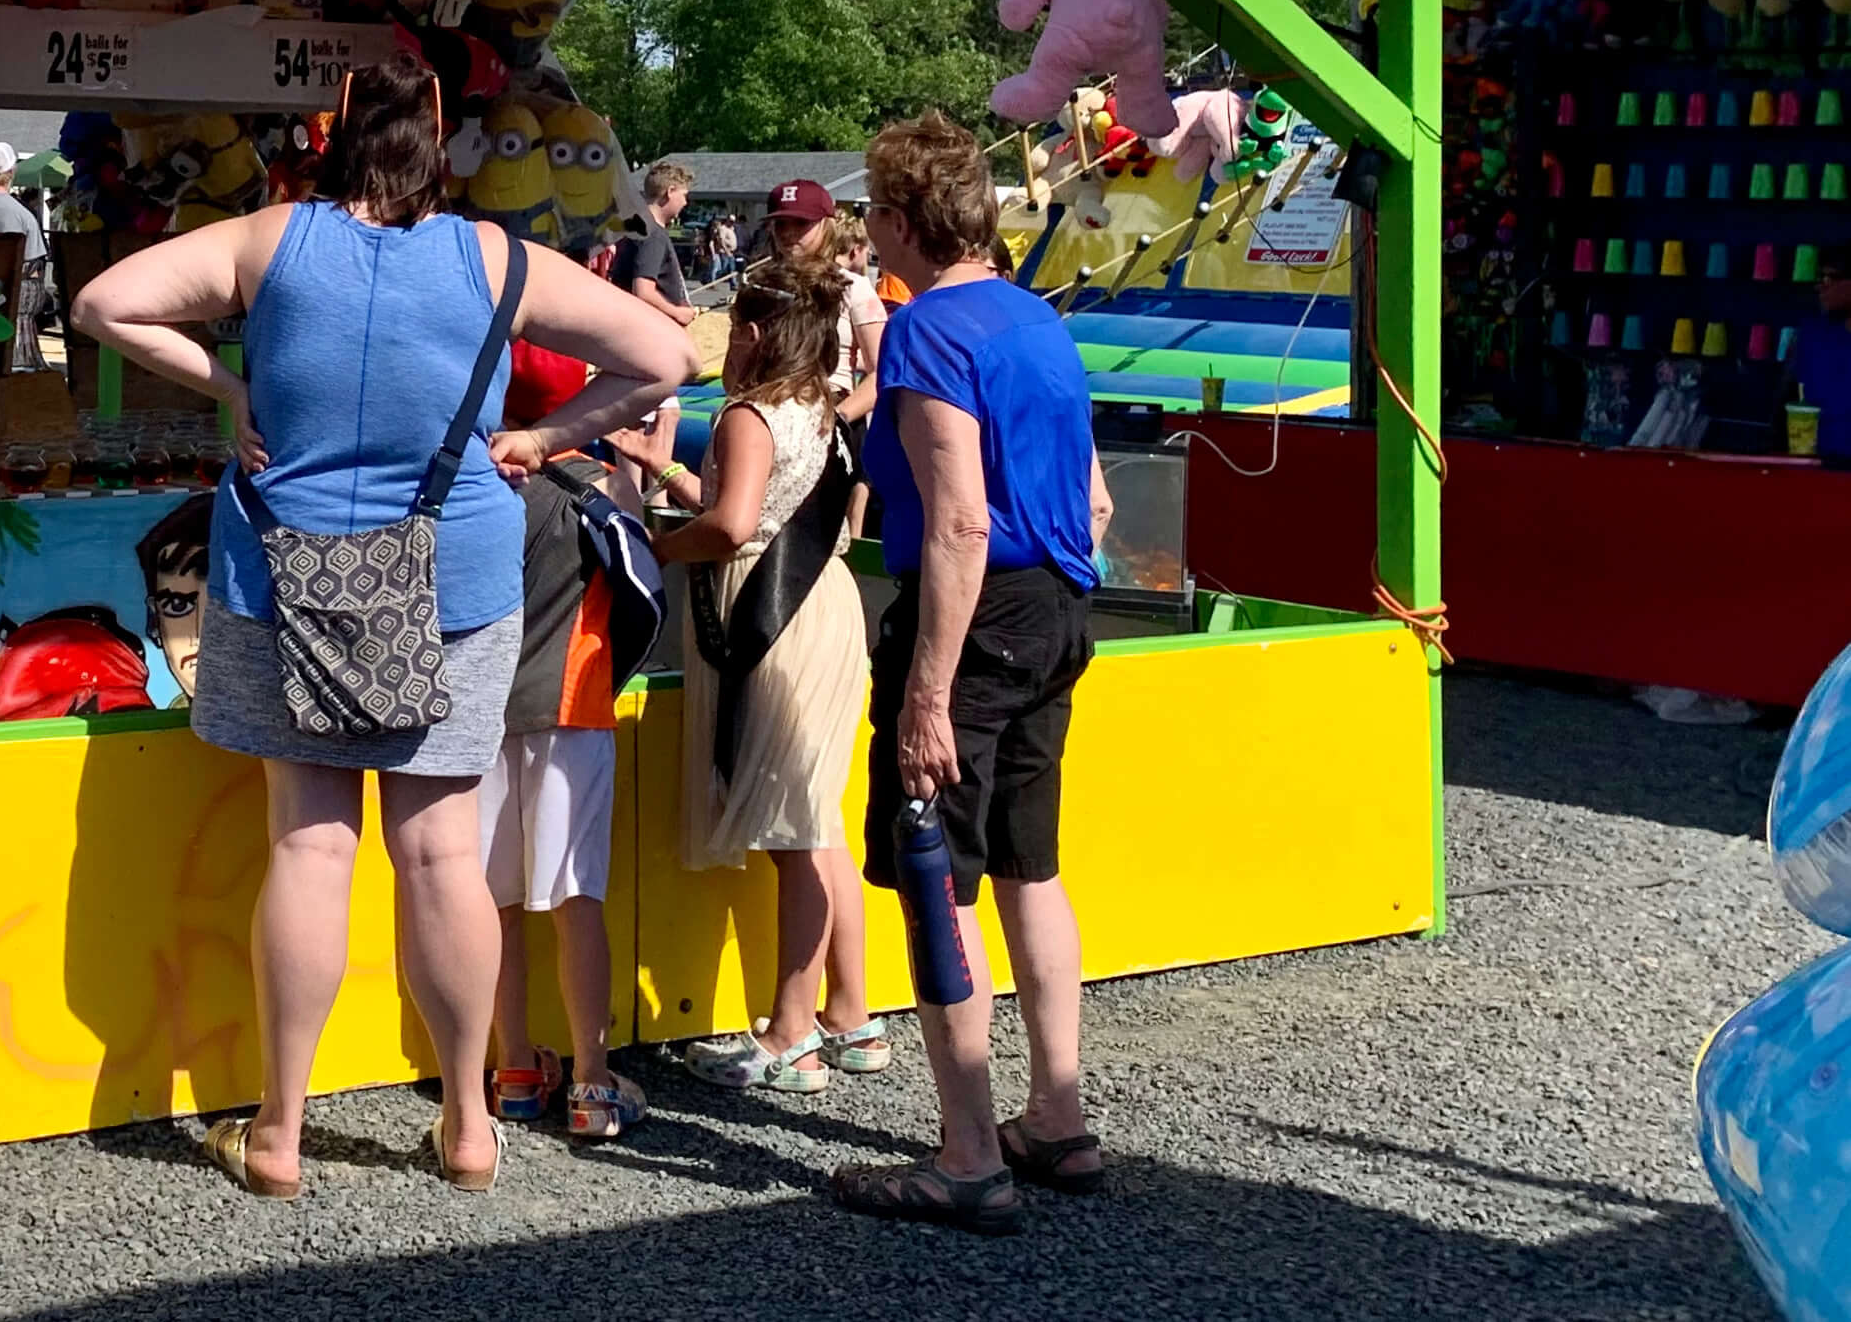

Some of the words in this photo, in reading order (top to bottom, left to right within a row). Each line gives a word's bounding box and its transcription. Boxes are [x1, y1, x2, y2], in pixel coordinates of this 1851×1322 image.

[46, 31, 84, 84] 24
[85, 34, 110, 49] balls
[113, 34, 128, 49] for
[275, 39, 310, 86] 54
[311, 41, 334, 56] balls
[780, 186, 799, 202] H
